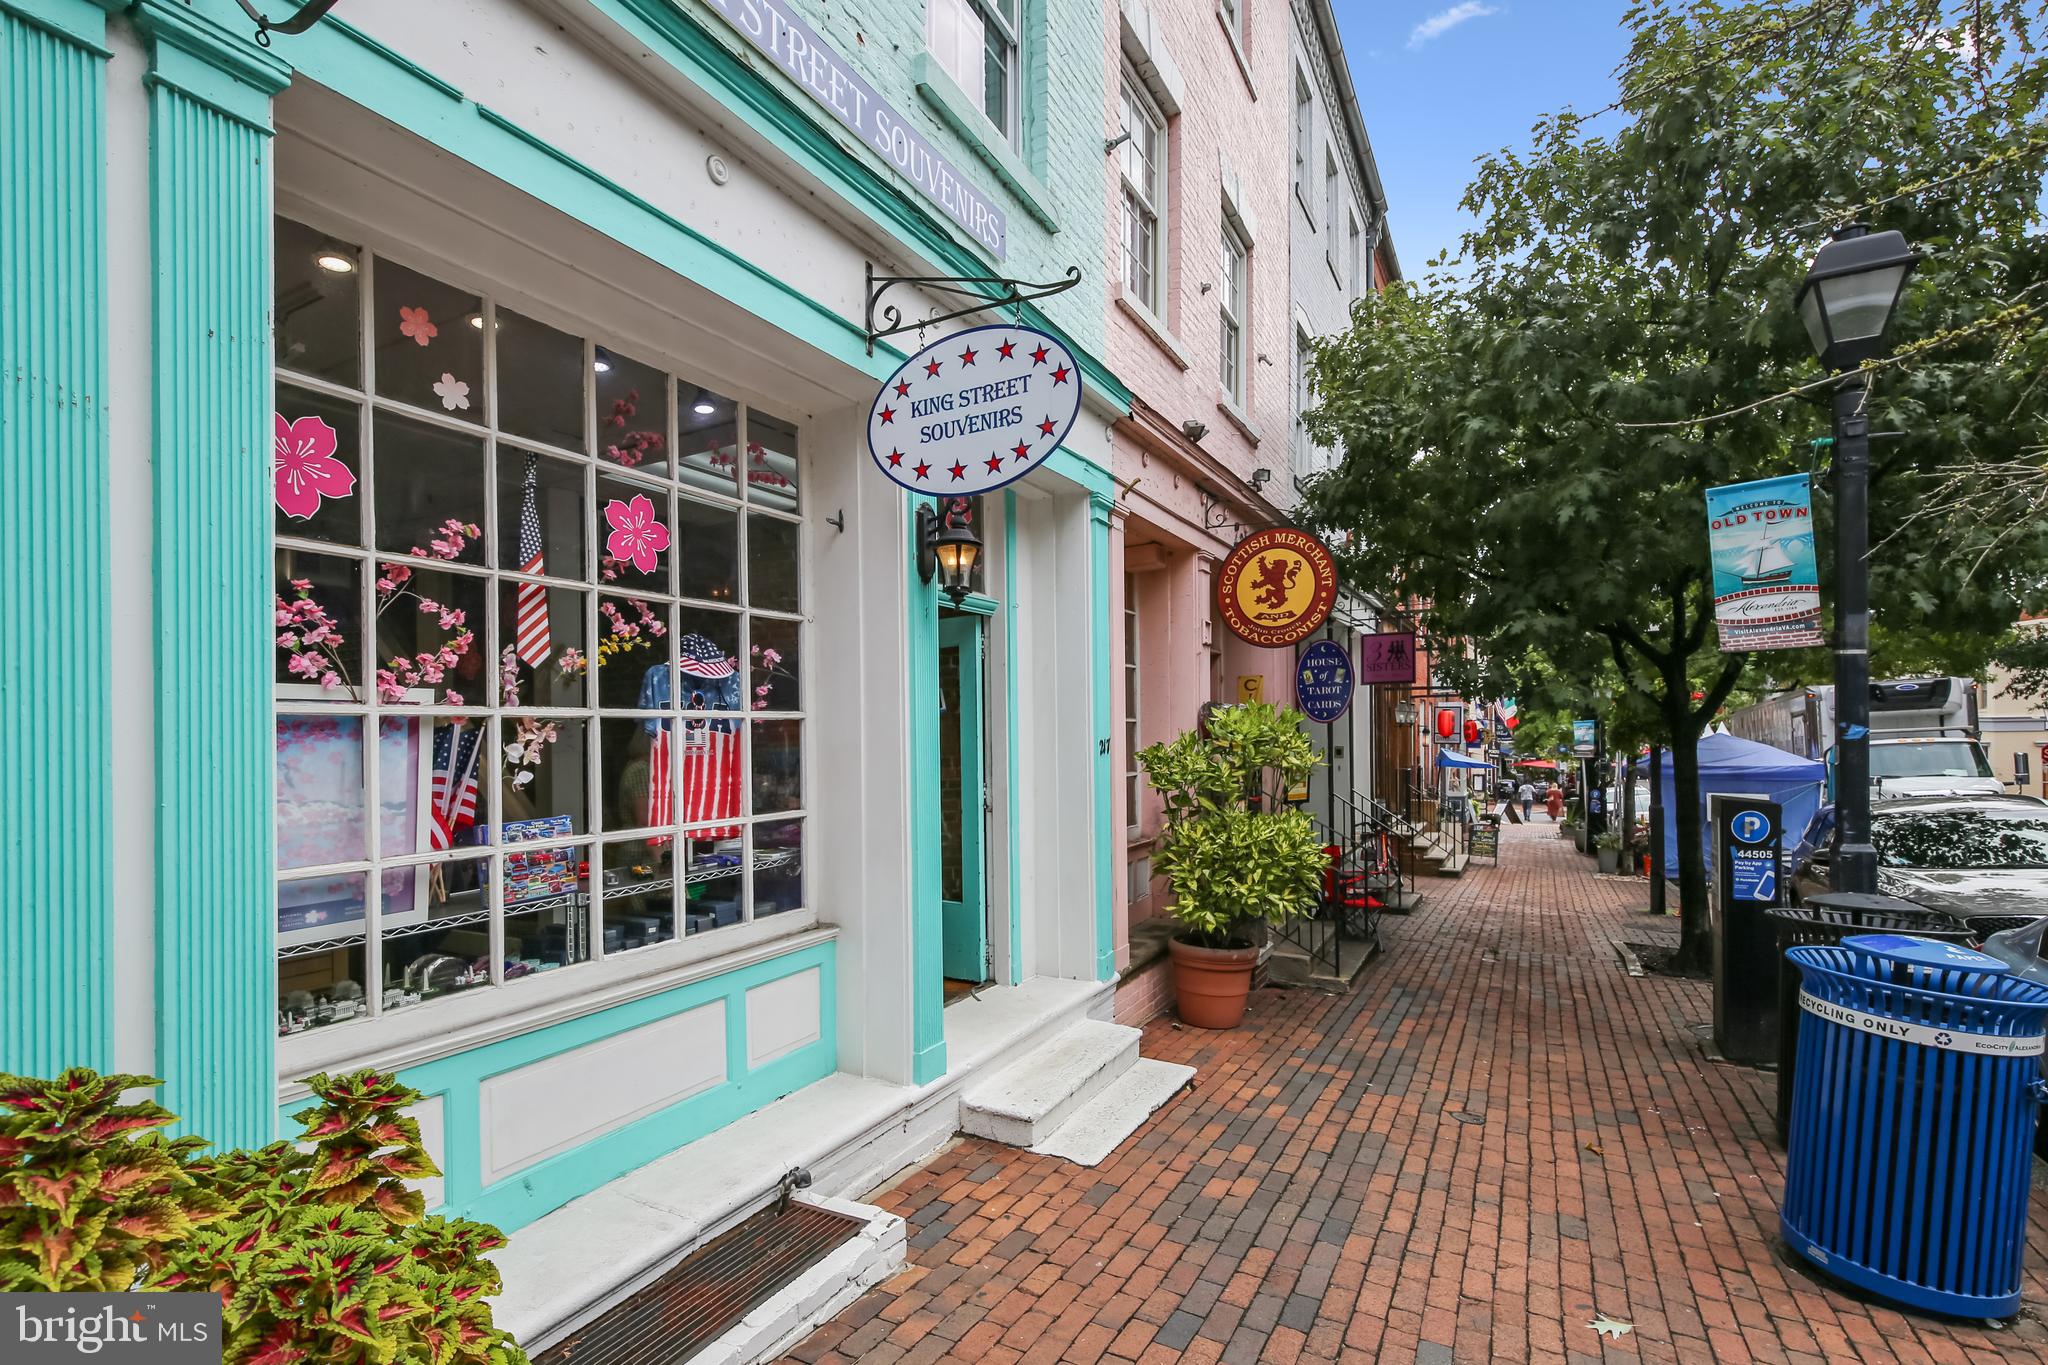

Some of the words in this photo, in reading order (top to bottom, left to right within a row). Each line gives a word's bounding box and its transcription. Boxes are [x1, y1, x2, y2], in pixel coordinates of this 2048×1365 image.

[739, 0, 868, 129] STREET
[875, 109, 1000, 249] SOUVENIRS
[911, 393, 954, 418] KING
[958, 373, 1032, 409] STREET
[919, 405, 1023, 444] SOUVENIRS
[1735, 502, 1769, 511] WELCOME
[1711, 514, 1747, 530] OLD
[1752, 507, 1808, 521] TOWN
[1222, 535, 1270, 594] SCOTTISH
[1274, 533, 1333, 587] MERCHANT
[1727, 595, 1807, 617] Alexandria
[1225, 601, 1328, 644] TOBACCONIST
[1247, 624, 1268, 634] John
[1734, 623, 1806, 635] VisitAlexandriaVA.com
[1307, 657, 1342, 668] HOUSE
[1366, 661, 1412, 673] SISTERS
[1319, 671, 1329, 681] of
[1306, 685, 1342, 695] TAROT
[1307, 700, 1342, 710] CARDS
[1744, 816, 1760, 838] P
[1737, 850, 1773, 859] 44505
[1800, 994, 1855, 1024] RECYCLING
[1863, 1018, 1910, 1037] ONLY
